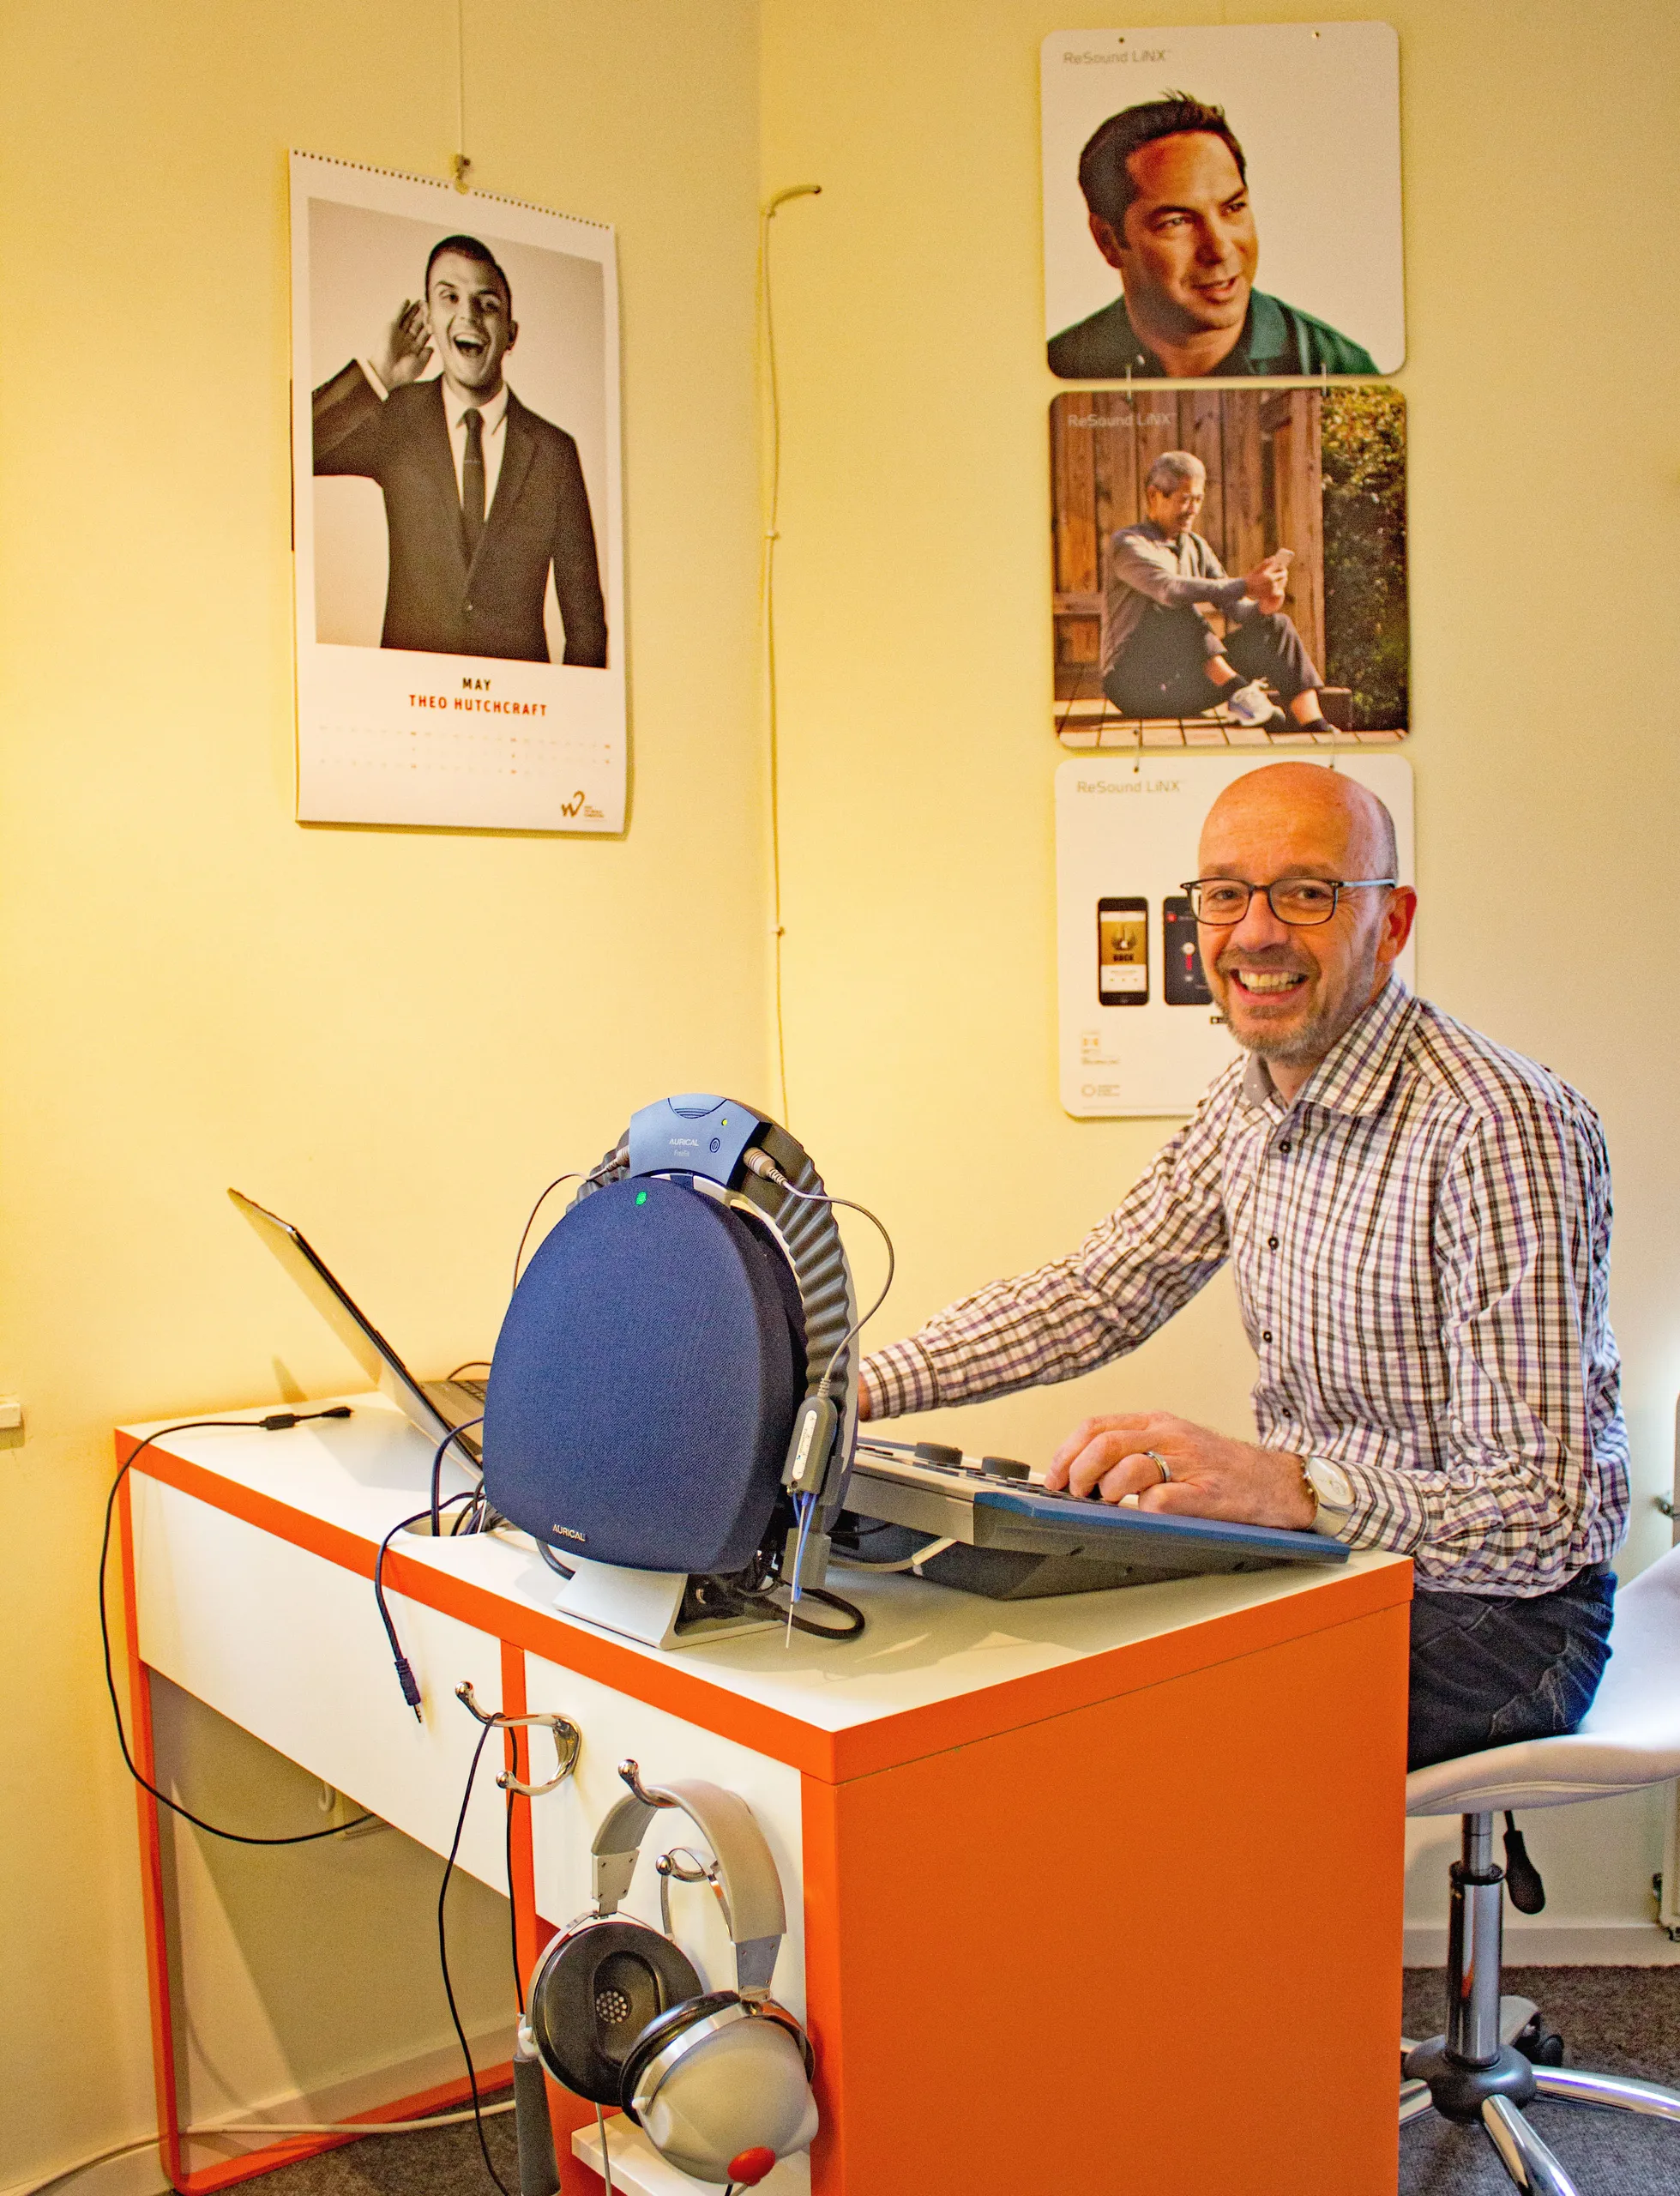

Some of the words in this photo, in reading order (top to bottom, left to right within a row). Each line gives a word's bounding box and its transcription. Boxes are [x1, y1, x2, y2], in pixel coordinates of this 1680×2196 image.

[1063, 51, 1128, 64] ReSound
[1068, 413, 1134, 427] ReSound
[462, 678, 491, 691] MAY
[408, 694, 448, 709] THEO
[454, 697, 547, 717] HUTCHCRAFT
[1076, 781, 1141, 793] ReSound
[1147, 781, 1180, 793] LiNX
[669, 1137, 699, 1147] AURICAL
[552, 1523, 586, 1541] AURICAL
